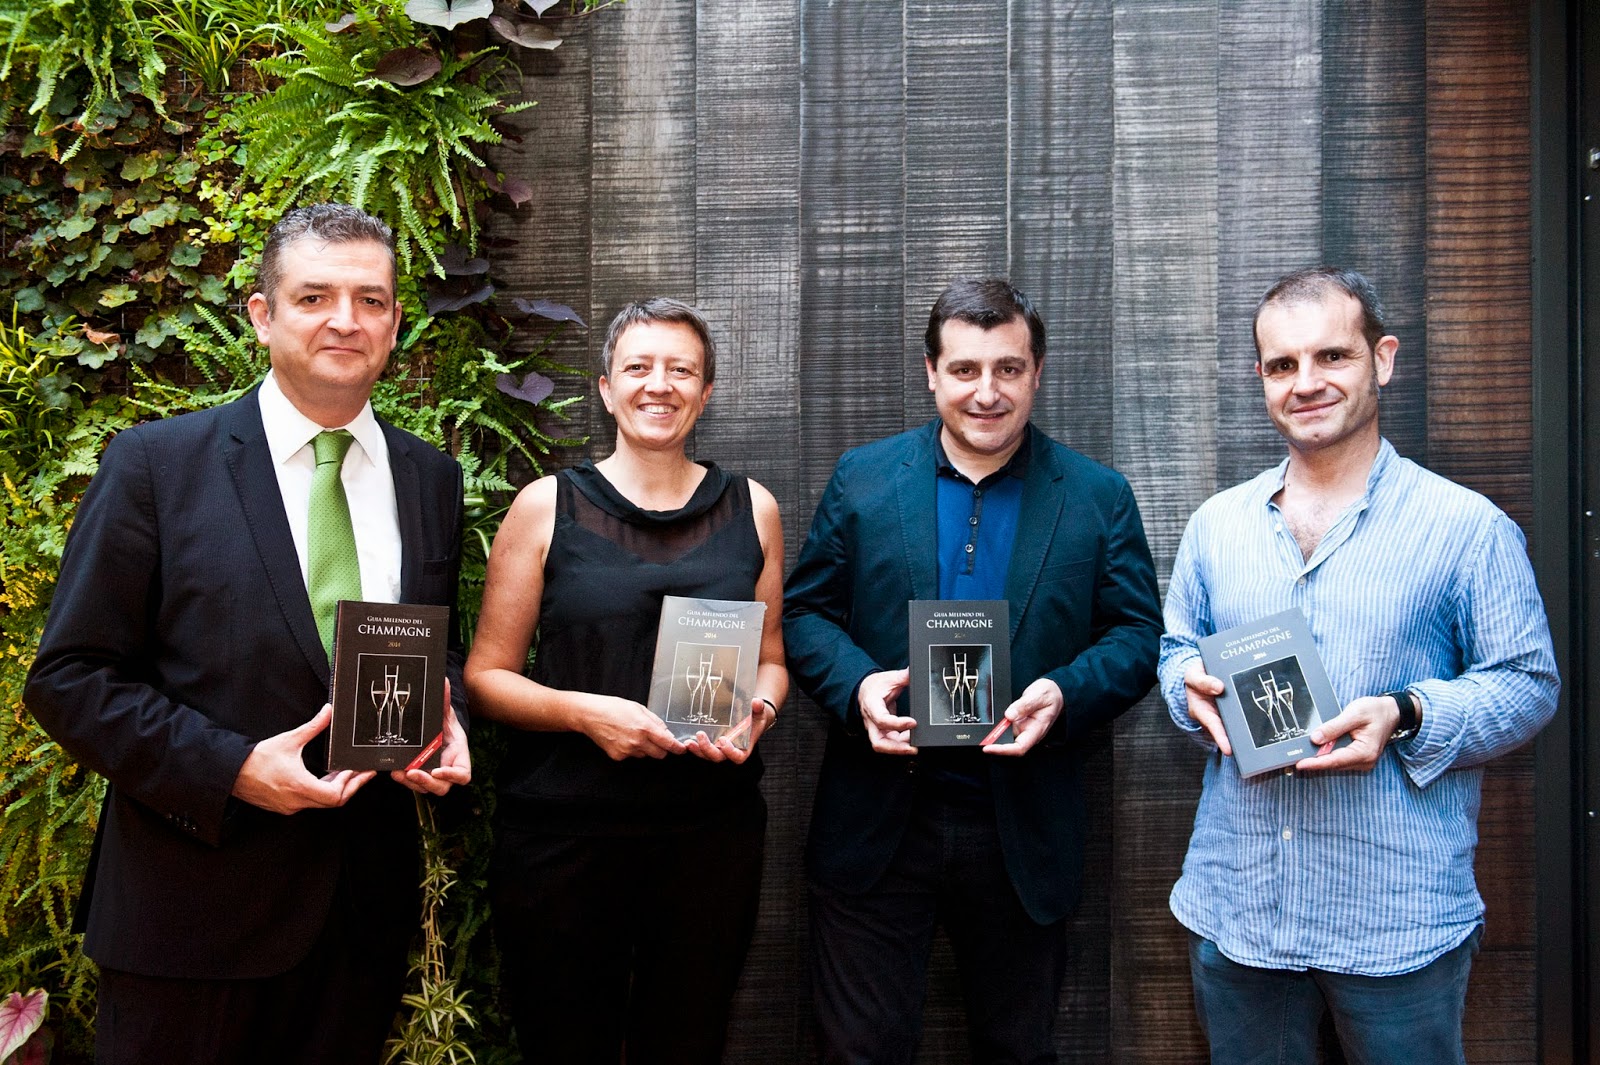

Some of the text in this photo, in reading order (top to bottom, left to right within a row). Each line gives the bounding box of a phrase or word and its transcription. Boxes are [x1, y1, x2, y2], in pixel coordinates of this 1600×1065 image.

[677, 616, 746, 630] CHAMPAGNE
[926, 619, 993, 629] CHAMPAGNE
[357, 624, 431, 638] CHAMPAGNE
[1240, 630, 1269, 643] MELENDO
[1220, 630, 1293, 660] CHAMPAGNE
